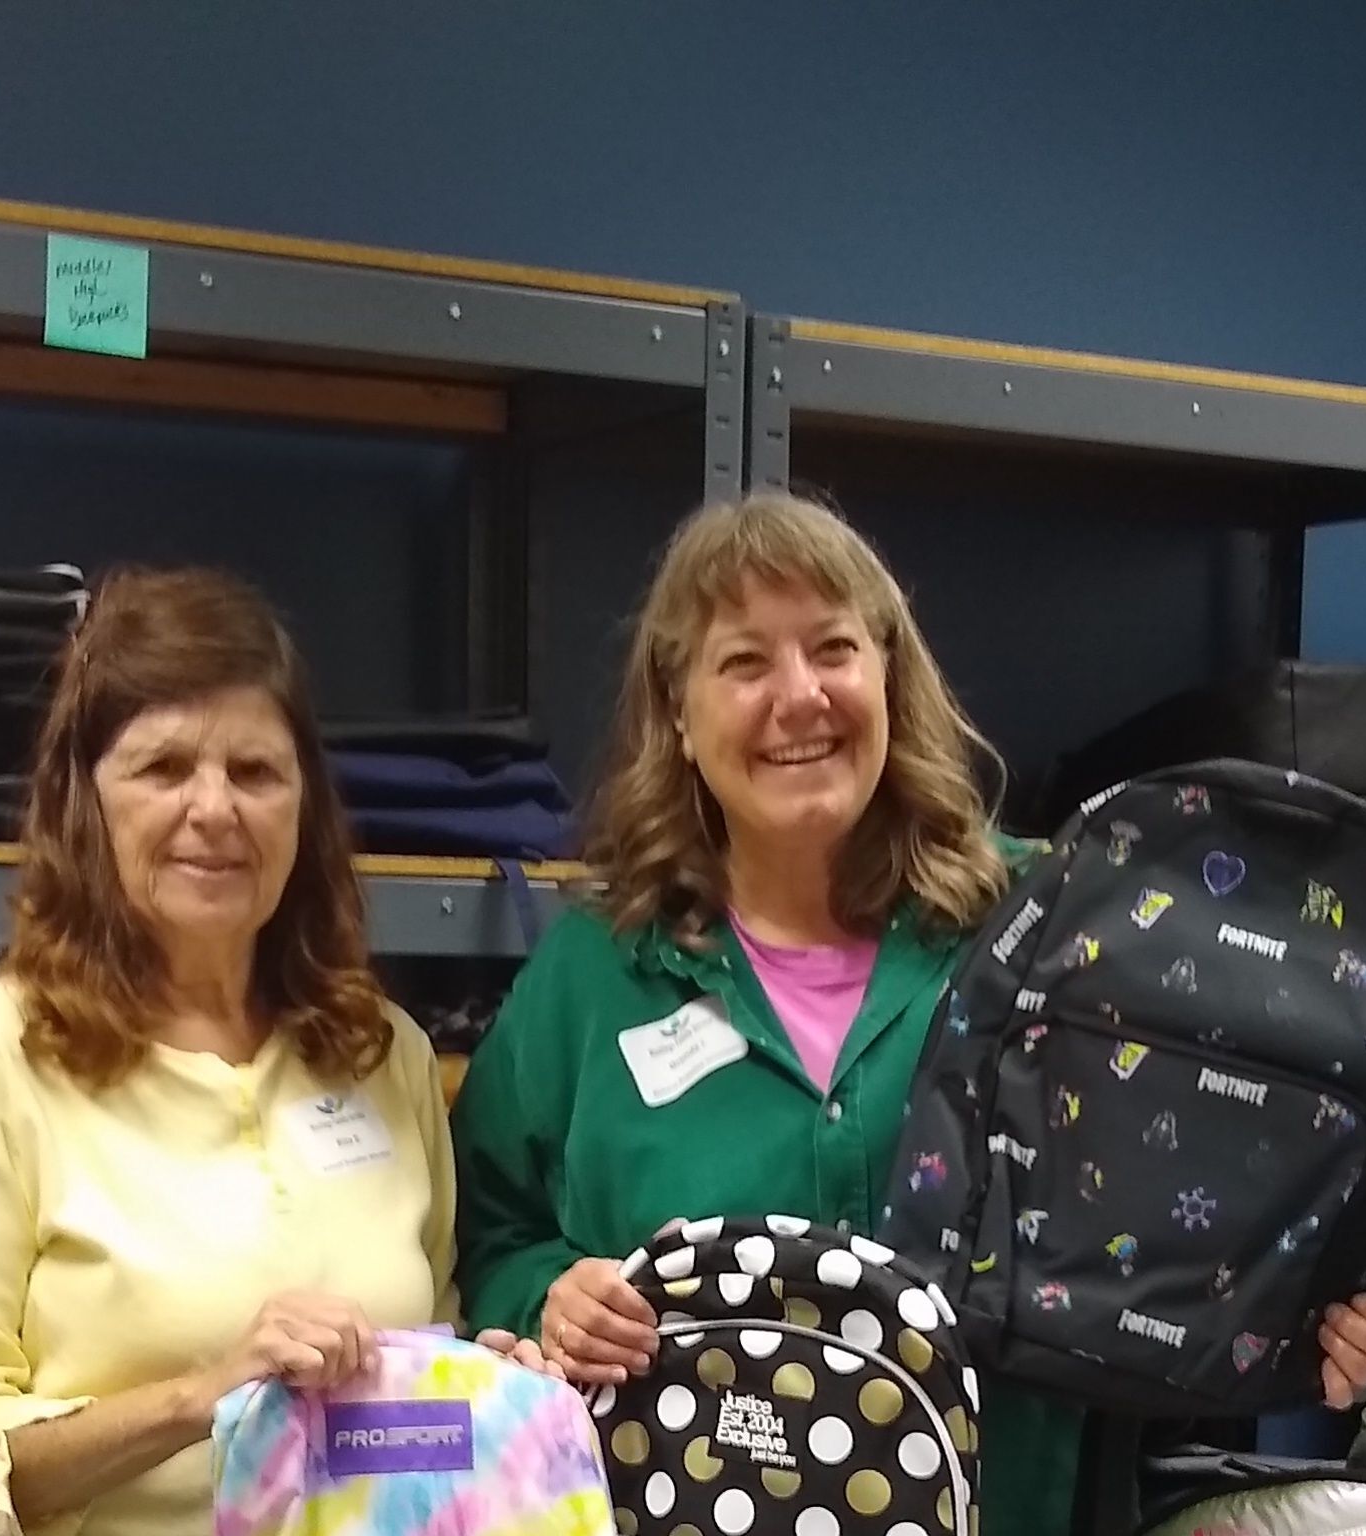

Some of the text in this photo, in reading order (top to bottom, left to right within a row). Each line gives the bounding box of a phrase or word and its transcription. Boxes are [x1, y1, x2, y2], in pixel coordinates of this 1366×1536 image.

[991, 897, 1044, 965] FORTNITE
[1217, 923, 1288, 962] FORTNITE
[1198, 1067, 1268, 1107] FORTNITE
[1118, 1309, 1186, 1349] FORTNITE
[720, 1389, 773, 1414] Justice
[335, 1424, 464, 1448] PROSPORT
[716, 1423, 788, 1454] Exclusive
[746, 1412, 784, 1437] 2004
